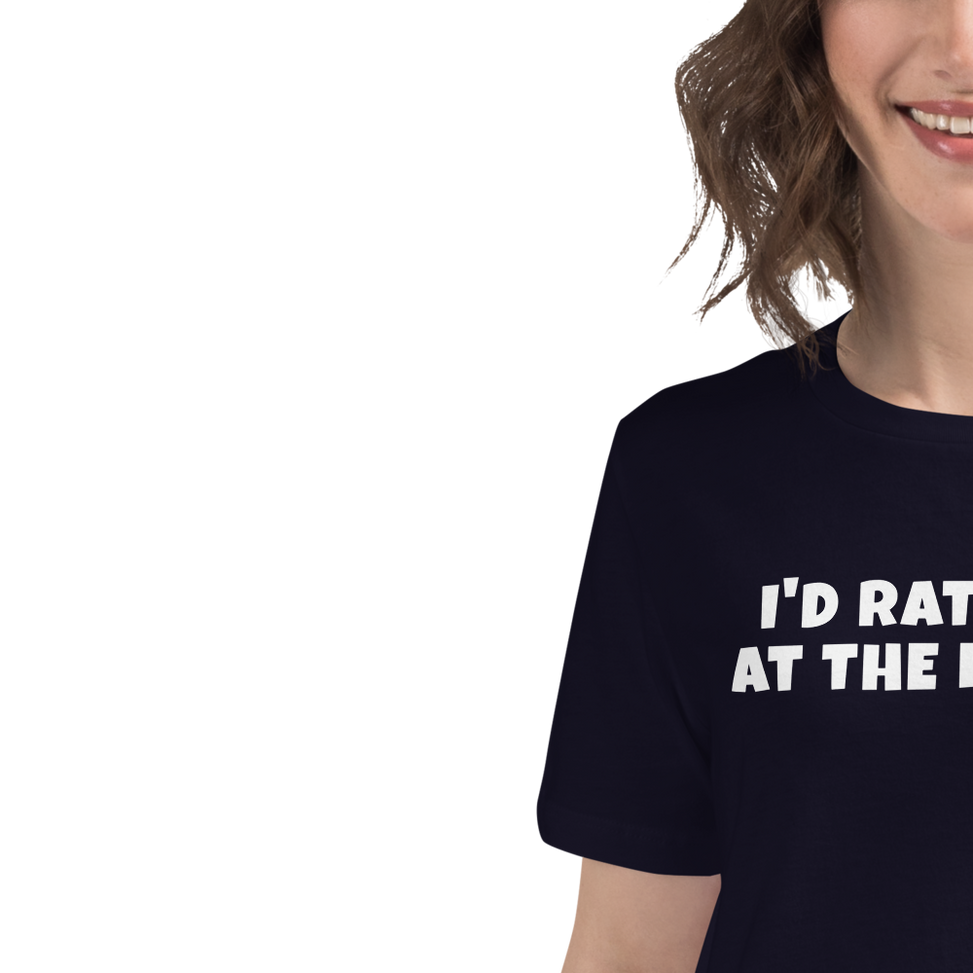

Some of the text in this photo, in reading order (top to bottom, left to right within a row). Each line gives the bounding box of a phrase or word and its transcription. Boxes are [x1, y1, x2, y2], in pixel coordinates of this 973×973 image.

[760, 576, 839, 630] I'D
[731, 644, 804, 693] AT
[821, 642, 940, 692] THE
